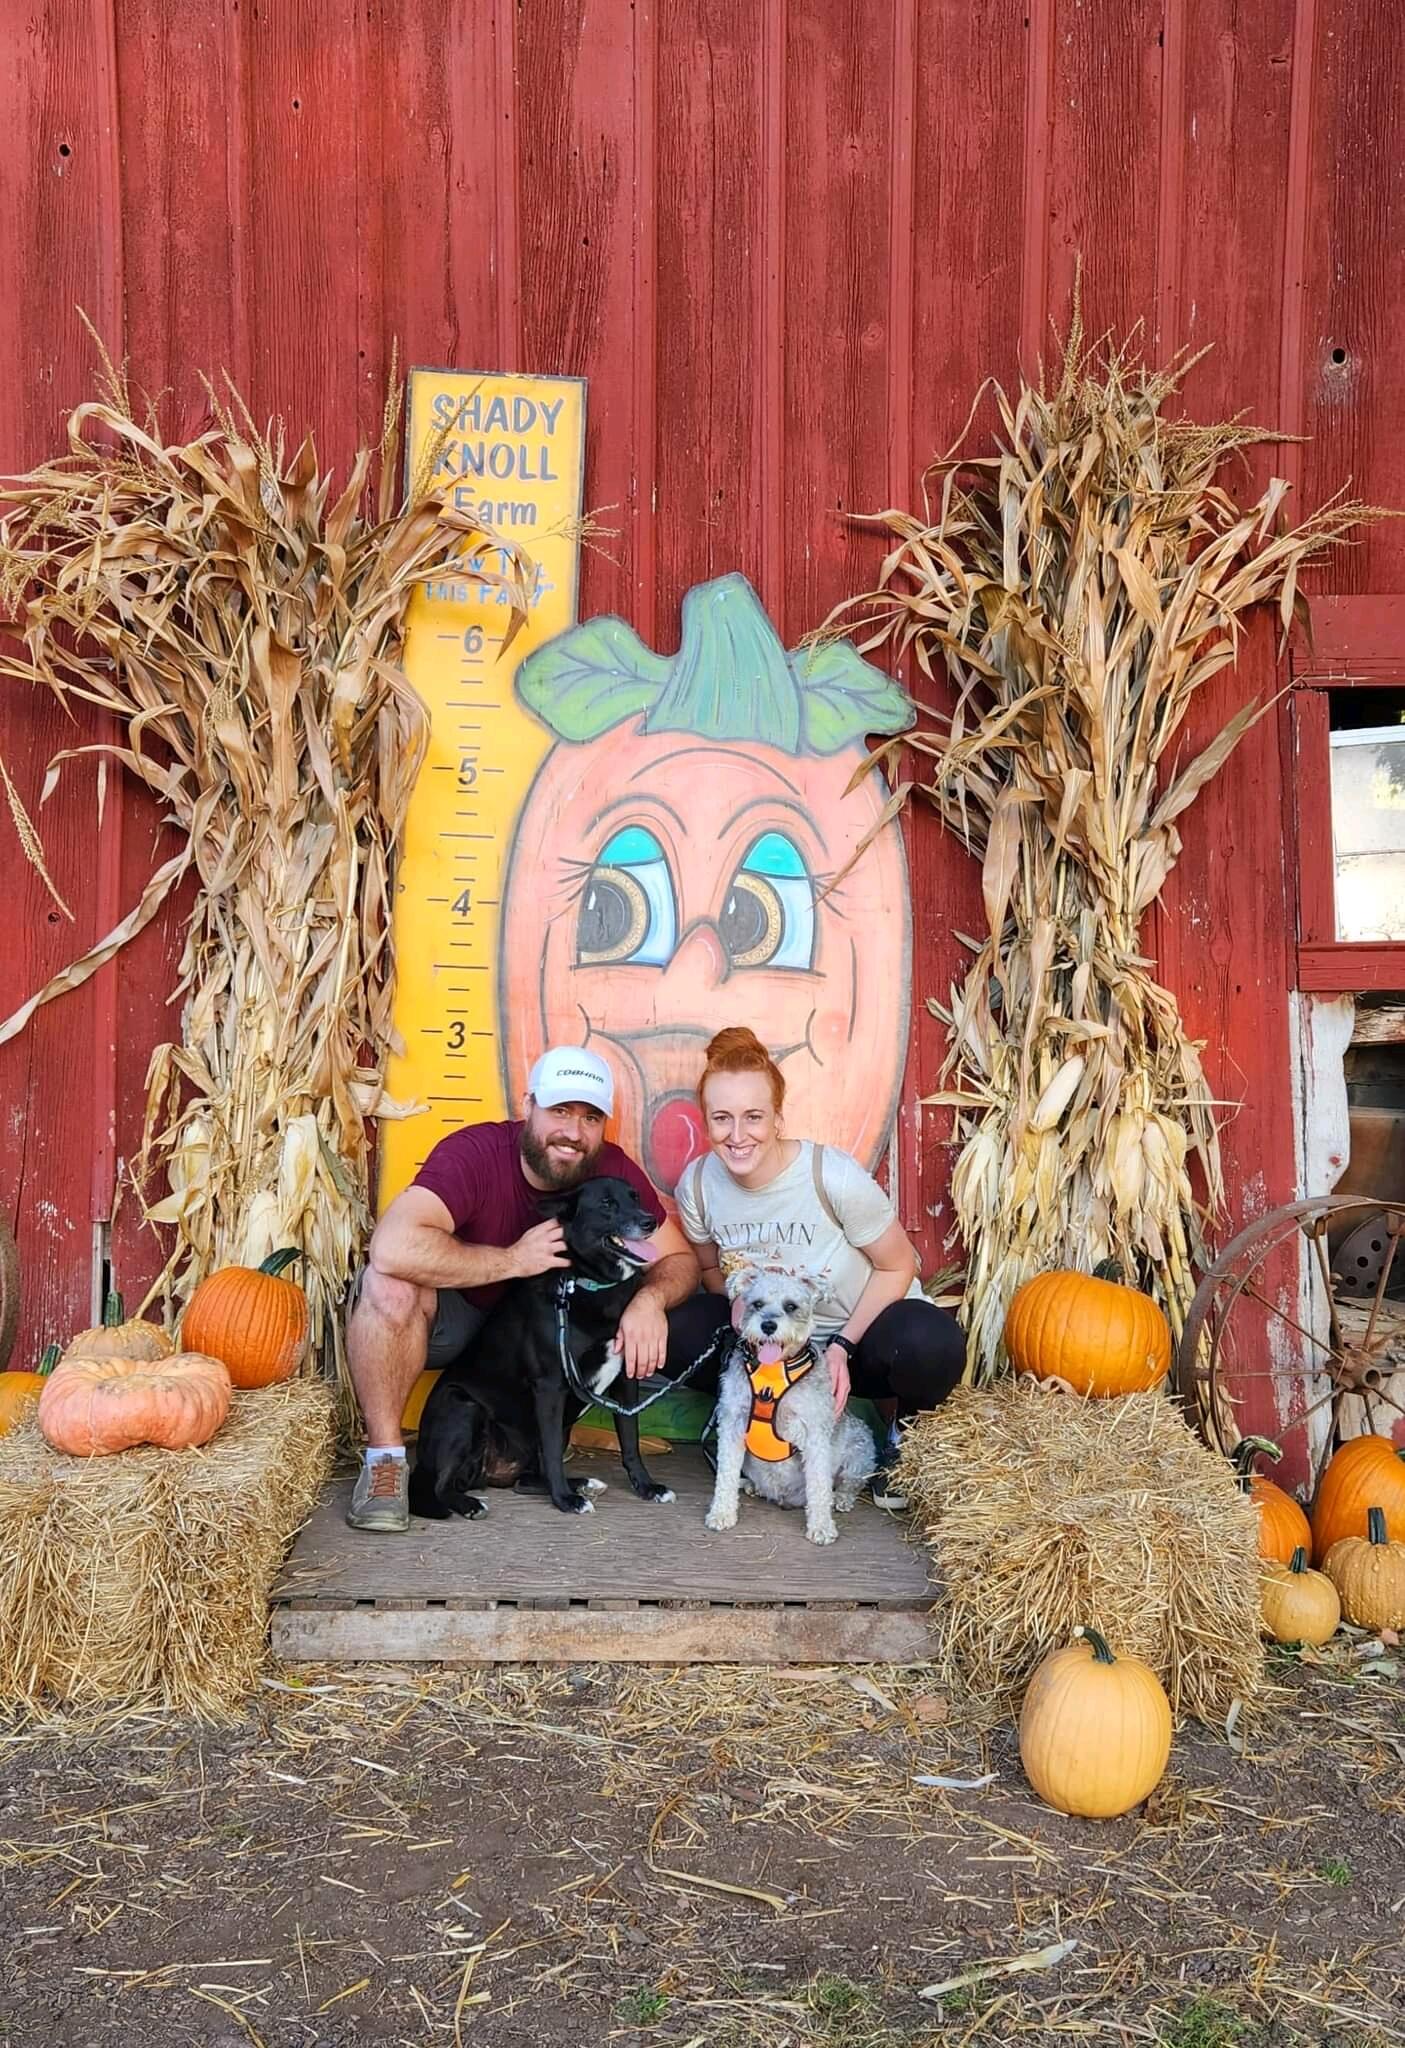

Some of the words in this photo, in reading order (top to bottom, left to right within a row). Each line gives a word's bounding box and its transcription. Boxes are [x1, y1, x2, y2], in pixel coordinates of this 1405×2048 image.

[431, 394, 564, 435] SHADY
[432, 440, 558, 481] KNOLL
[454, 486, 537, 525] Farm
[463, 625, 484, 654] 6
[457, 757, 478, 785] 5
[451, 889, 471, 917] 4
[446, 1021, 466, 1049] 3
